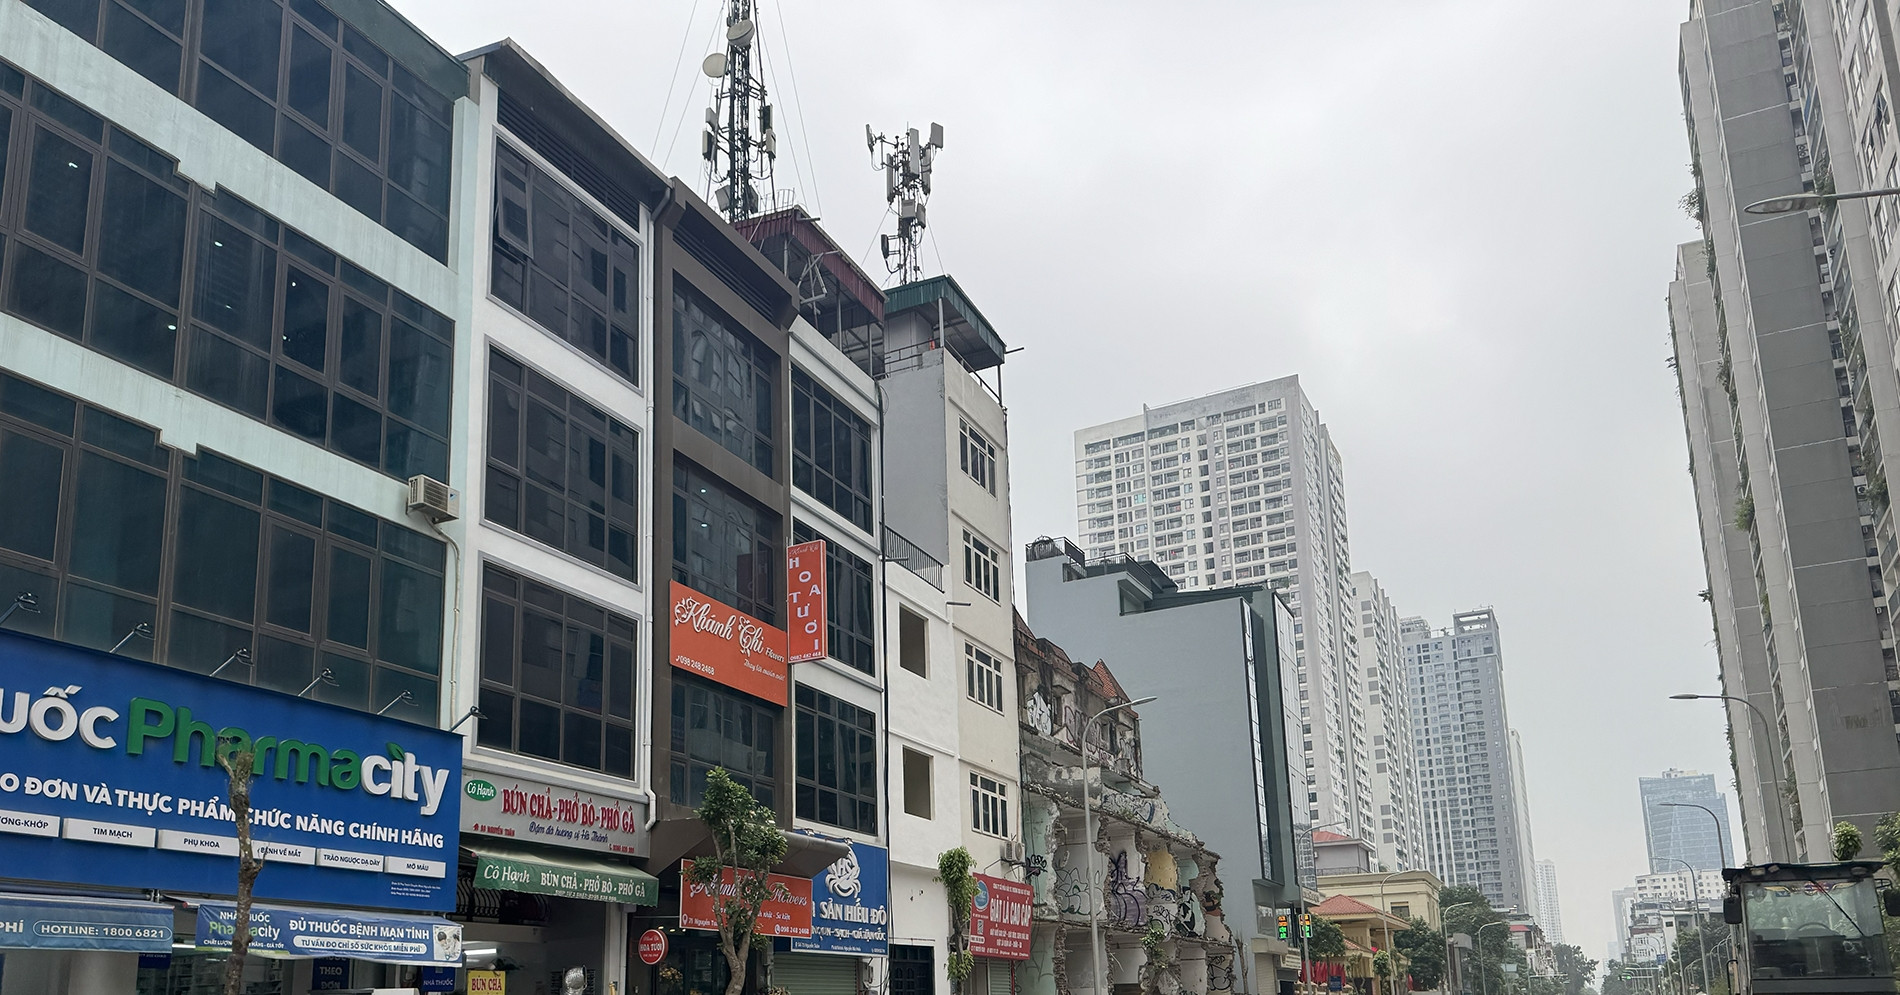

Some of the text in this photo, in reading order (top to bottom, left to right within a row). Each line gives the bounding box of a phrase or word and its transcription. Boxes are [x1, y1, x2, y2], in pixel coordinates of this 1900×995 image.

[789, 557, 821, 596] HOA
[675, 596, 736, 640] Khánh
[739, 616, 764, 657] Chi
[680, 655, 690, 666] 098
[0, 685, 450, 816] UỐC Pharmacity
[467, 782, 494, 798] Cô Hạnh
[0, 773, 20, 793] O
[24, 776, 78, 801] ĐƠN
[83, 782, 112, 805] VÀ
[115, 789, 172, 816] THỰC
[177, 796, 236, 822] PHẨM
[295, 814, 344, 836] NĂNG
[349, 822, 398, 843] CHÍNH
[401, 829, 444, 849] HÃNG
[501, 783, 528, 815] BÚN
[621, 805, 635, 835] GÀ
[0, 816, 49, 829] ƠNG-KHỚP
[92, 827, 133, 839] TIM MẠCH
[183, 838, 220, 848] PHỤ KHOA
[323, 854, 339, 862] TRÀO
[361, 858, 370, 867] DẠ
[370, 858, 381, 867] DÀY
[484, 864, 500, 879] Cô
[502, 866, 530, 884] Hạnh
[541, 869, 559, 887] BÚN
[560, 872, 577, 889] CHẢ
[583, 875, 600, 892] PHỞ
[601, 878, 612, 893] BÒ
[618, 879, 634, 896] PHỞ
[635, 882, 645, 897] GÀ
[690, 873, 737, 898] Knh
[220, 910, 270, 923] NHÀ UỐC
[819, 897, 843, 921] SẢN
[844, 898, 869, 924] HIẾU
[869, 904, 887, 926] ĐÔ
[41, 924, 164, 938] HOTLINE: 1800 6821
[209, 921, 280, 941] Phaacity
[289, 917, 429, 940] ĐỦ THUỐC BỆNH MẠN TÍNH
[217, 939, 232, 947] LƯỢN
[301, 938, 310, 946] TƯ
[311, 939, 325, 948] VẤN
[350, 941, 360, 950] SỐ
[360, 942, 373, 950] SỨC
[320, 966, 342, 976] THEO
[436, 978, 453, 986] THUỐC
[471, 975, 486, 991] BÚN
